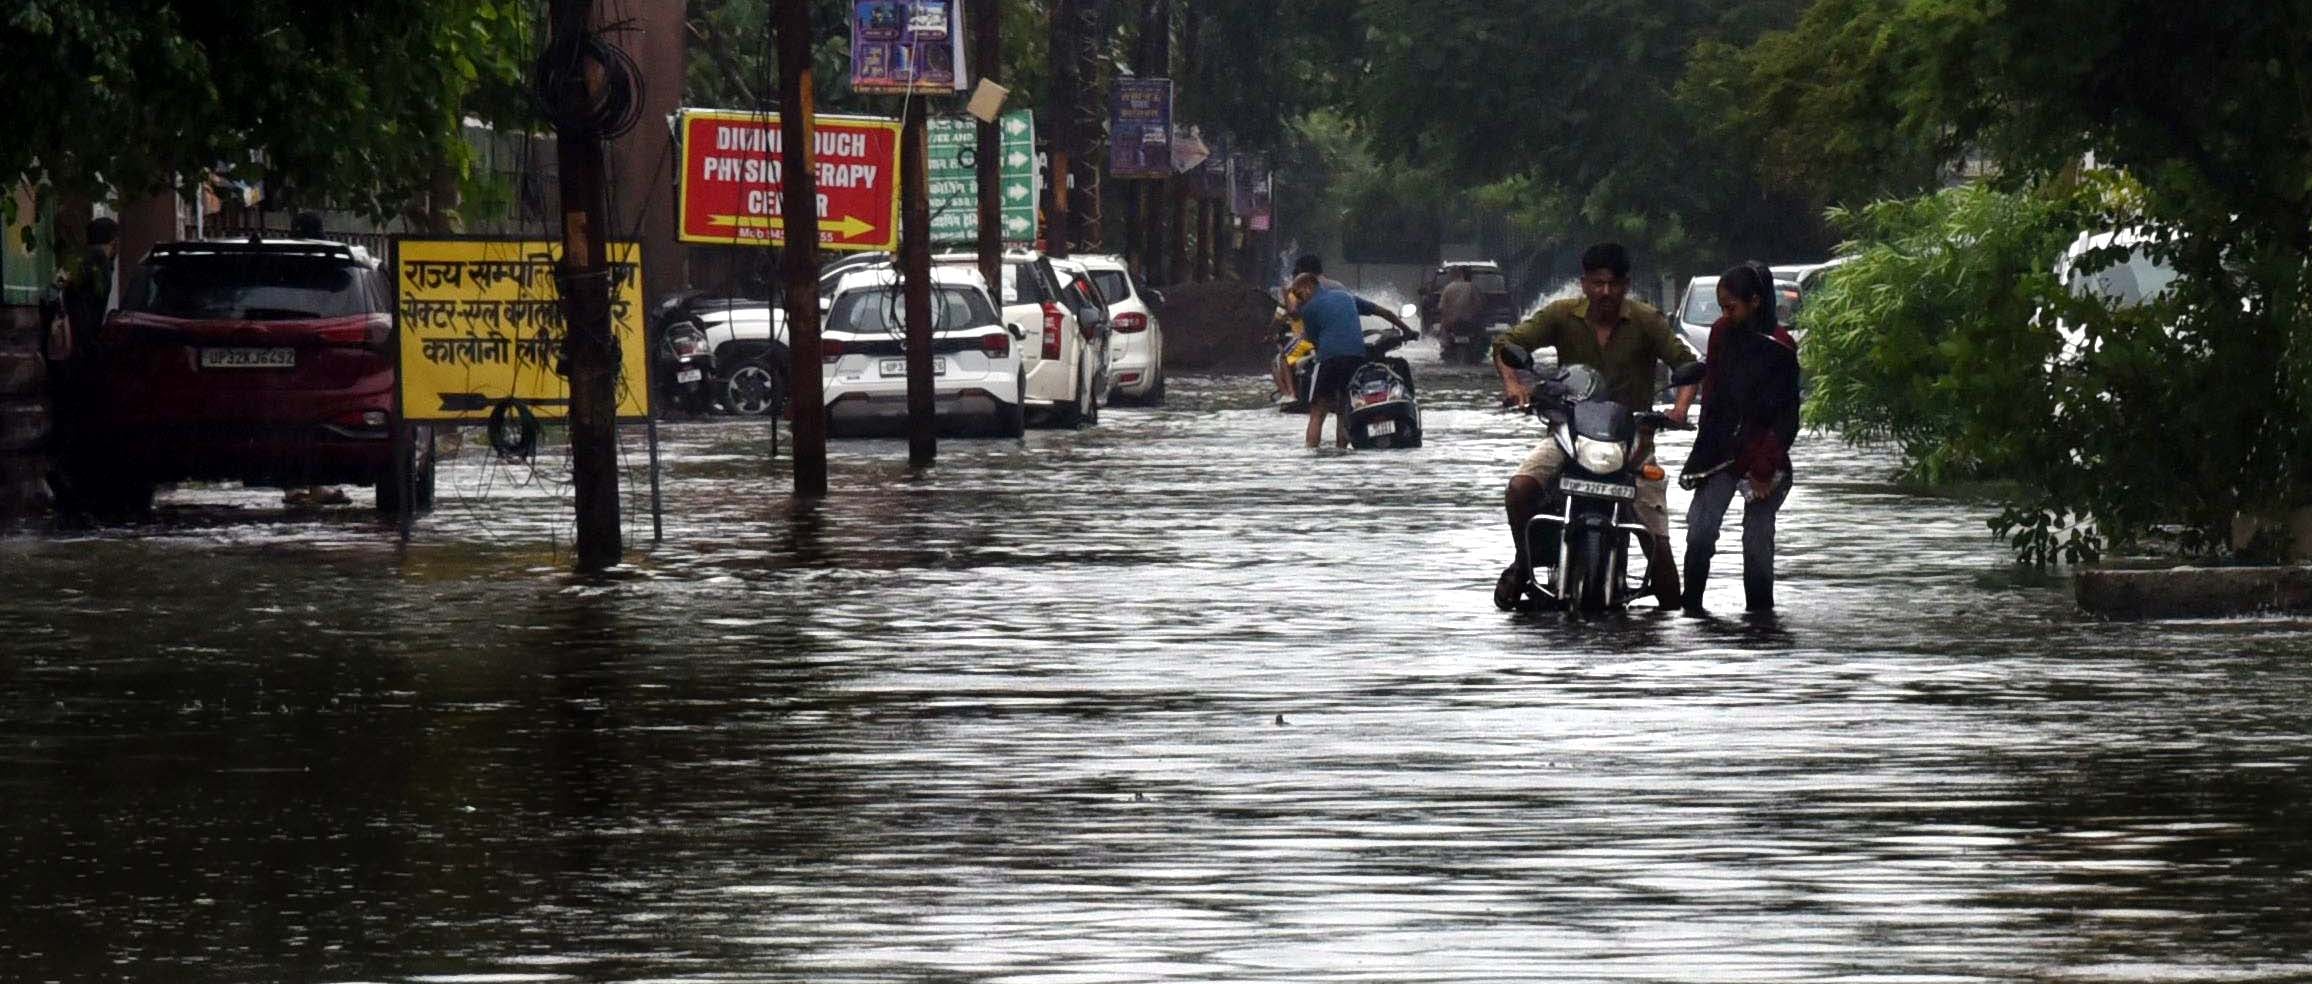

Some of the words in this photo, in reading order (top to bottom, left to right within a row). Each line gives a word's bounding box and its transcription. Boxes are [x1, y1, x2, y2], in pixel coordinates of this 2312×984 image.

[814, 132, 866, 158] OUCH
[704, 157, 877, 189] PHYSIORAPY
[748, 190, 829, 217] CENR
[404, 260, 467, 291] राज्य
